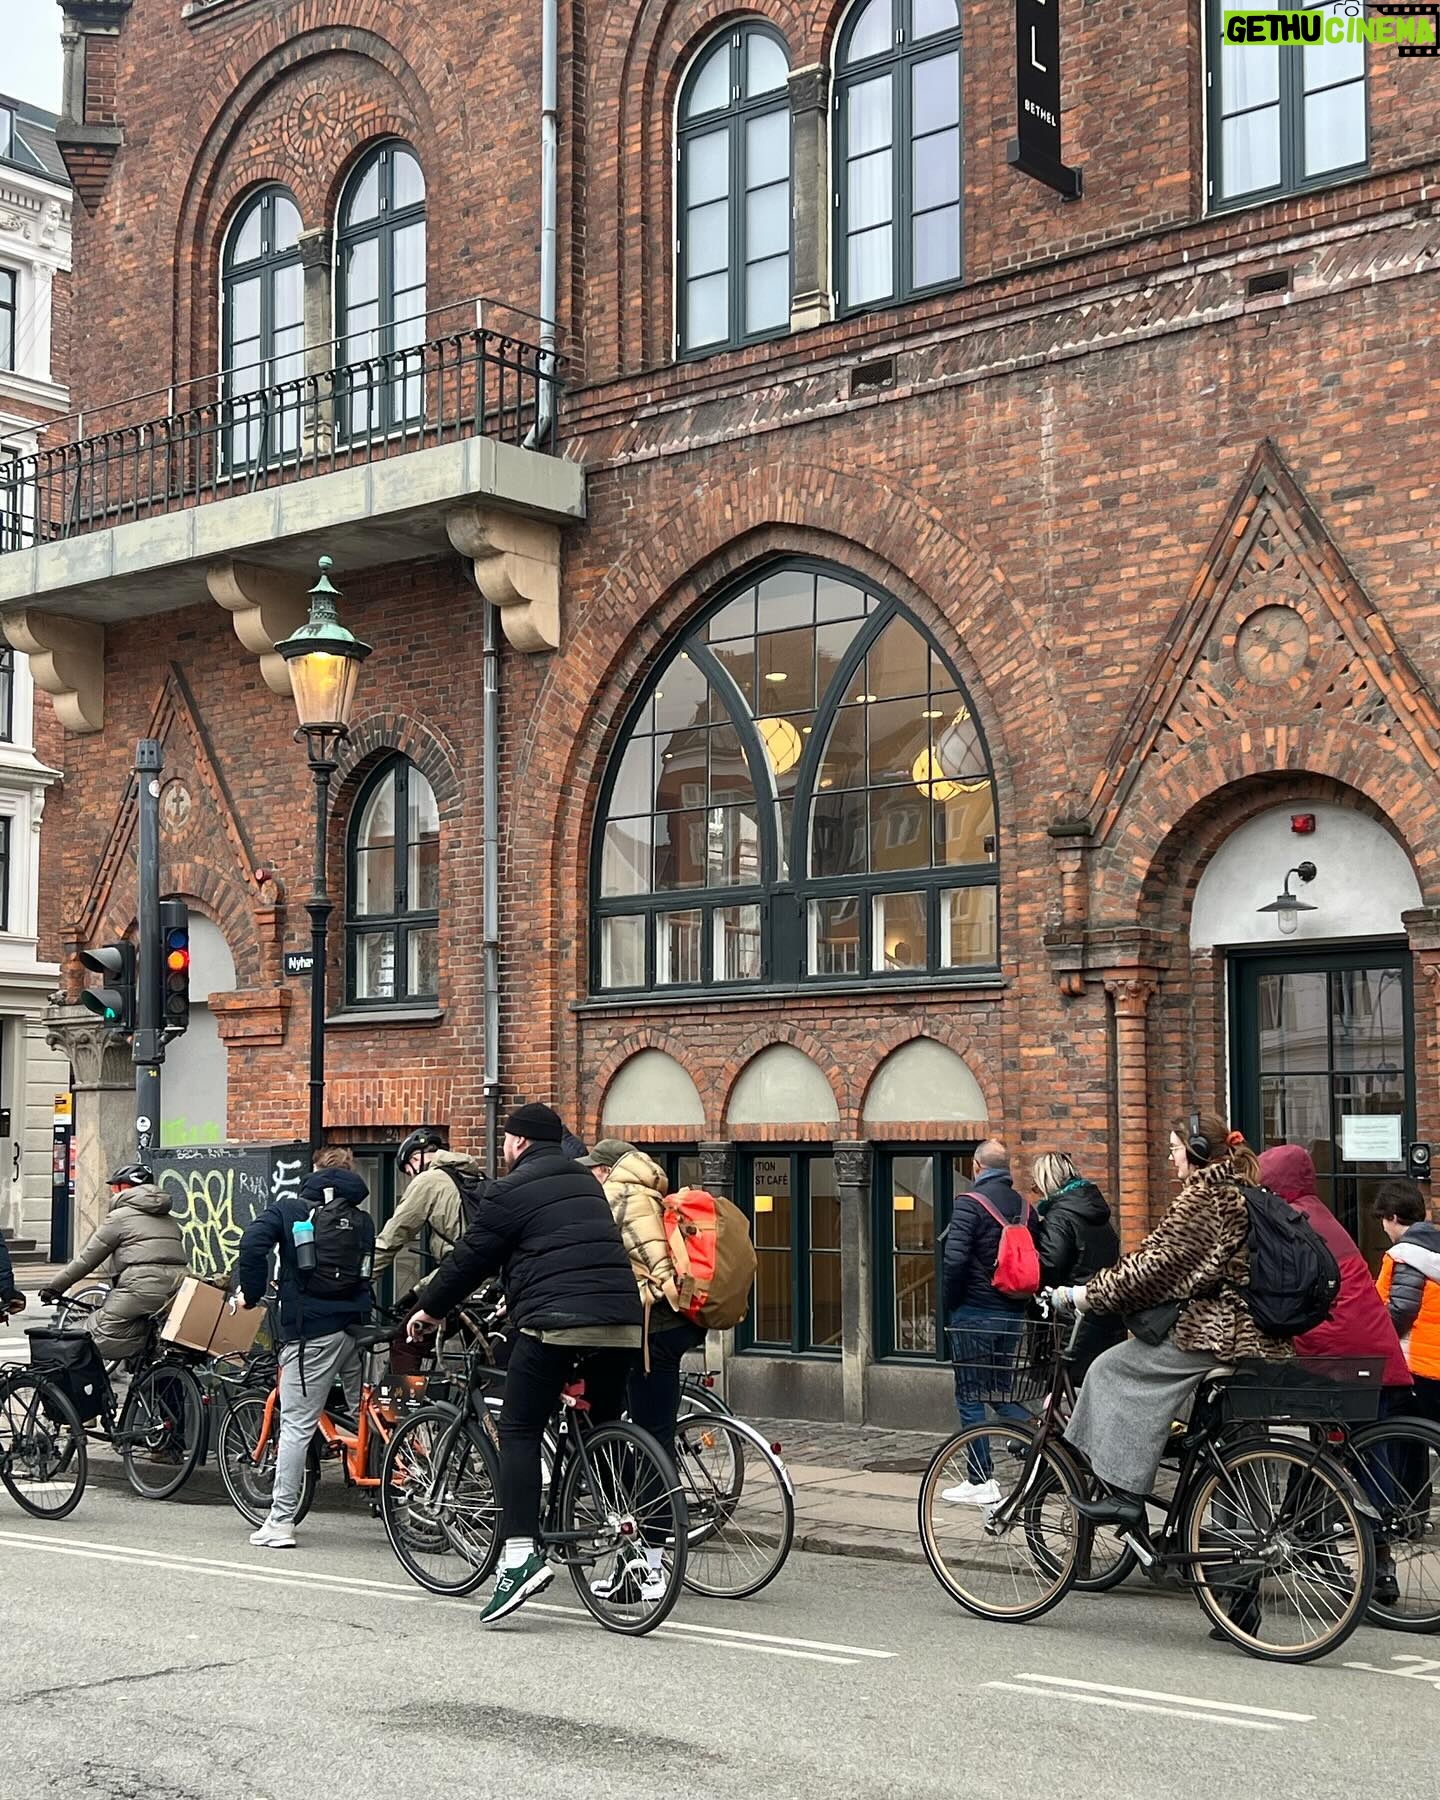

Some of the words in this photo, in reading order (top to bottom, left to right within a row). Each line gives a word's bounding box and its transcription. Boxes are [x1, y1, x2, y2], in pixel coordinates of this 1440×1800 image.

[1024, 98, 1057, 127] BETHEL
[755, 1161, 776, 1171] TION
[767, 1171, 789, 1185] CAFÉ
